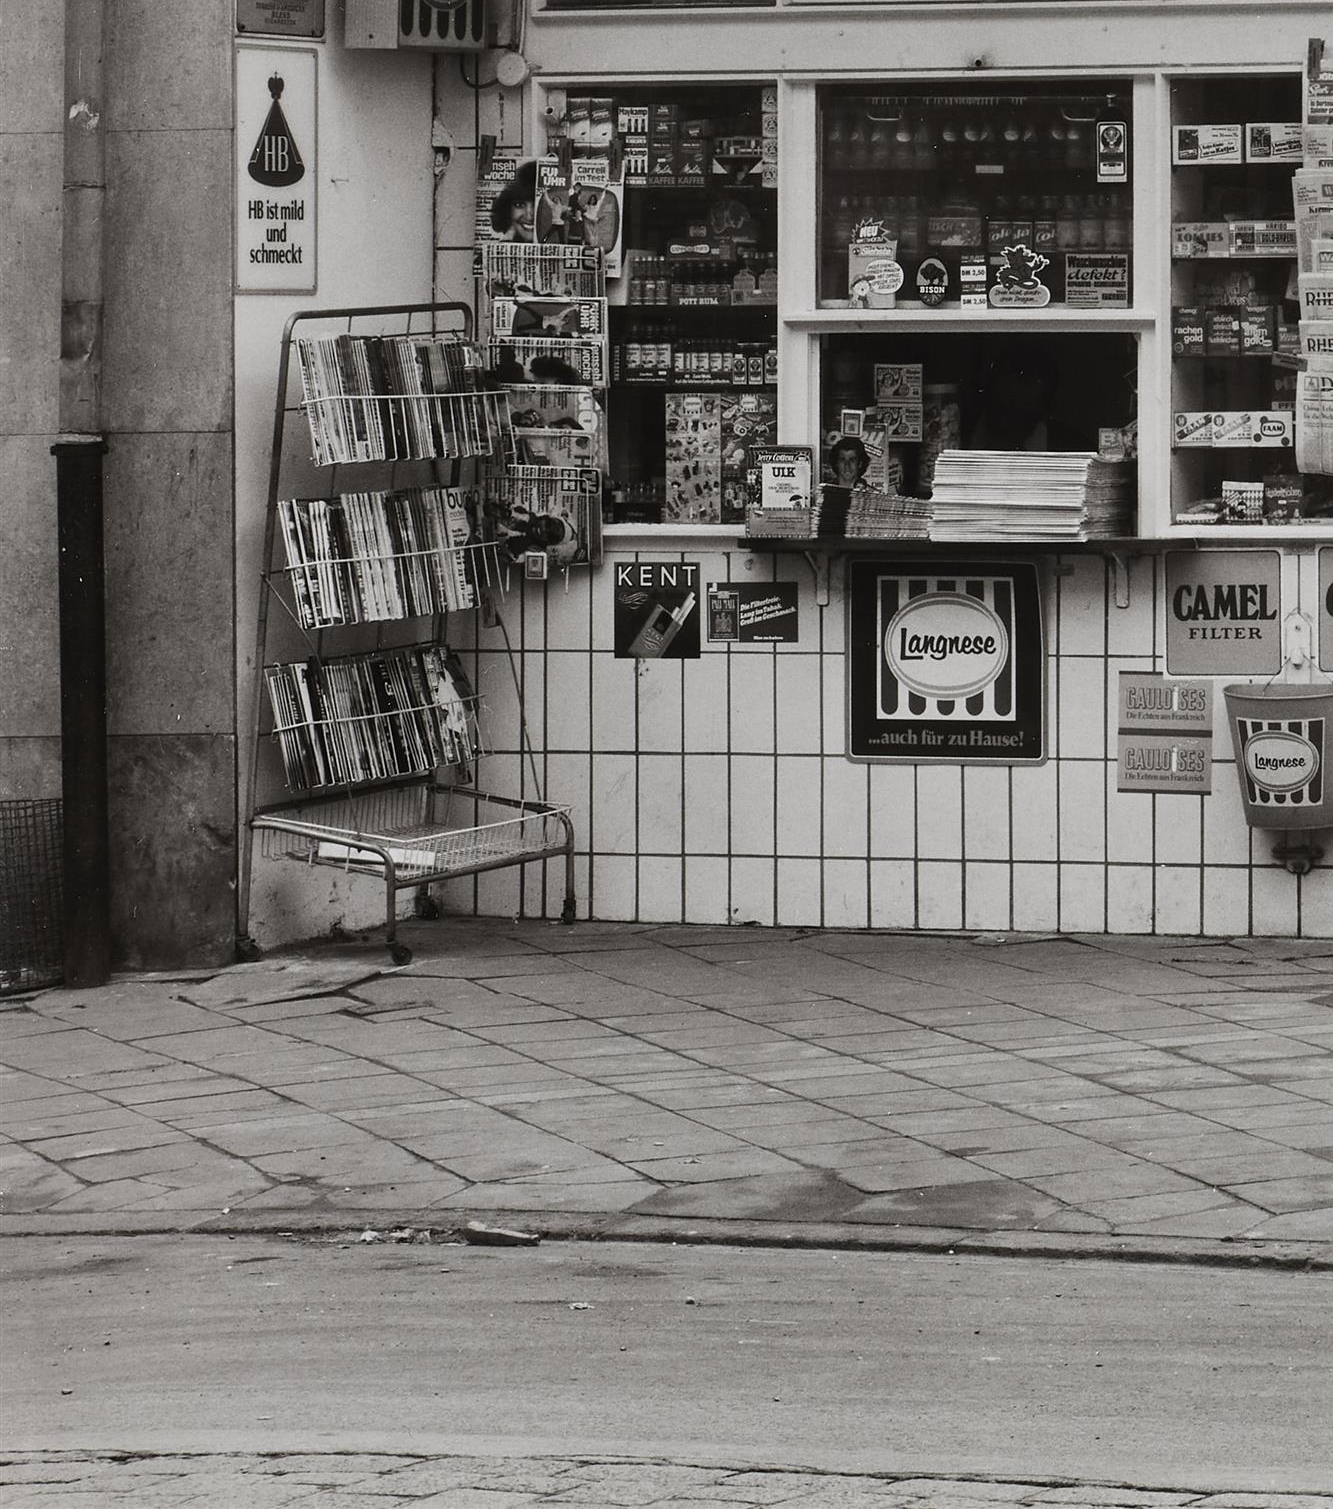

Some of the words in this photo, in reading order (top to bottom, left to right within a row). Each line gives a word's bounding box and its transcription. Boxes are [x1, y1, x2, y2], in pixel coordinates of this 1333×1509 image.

[264, 135, 289, 172] HB
[543, 177, 567, 187] UHR
[650, 176, 676, 185] KAFFEE
[677, 176, 705, 185] KAFFEE
[248, 200, 264, 219] HB
[266, 199, 280, 220] ist
[280, 199, 304, 220] mild
[266, 221, 287, 242] und
[859, 225, 880, 239] NEU
[249, 243, 303, 264] schmeckt
[919, 285, 945, 295] BISON
[1174, 325, 1203, 335] rachen
[1183, 334, 1203, 345] gold
[771, 467, 796, 478] ULK
[618, 565, 697, 587] KENT
[1172, 583, 1278, 622] CAMEL
[1188, 626, 1263, 640] FILTER
[900, 627, 997, 661] Langnese
[1126, 684, 1206, 711] GAULOISES
[921, 729, 944, 746] für
[948, 733, 967, 746] zu
[969, 730, 1024, 747] Hause!
[1125, 745, 1205, 772] GAULOISES
[1254, 751, 1306, 771] Langnese
